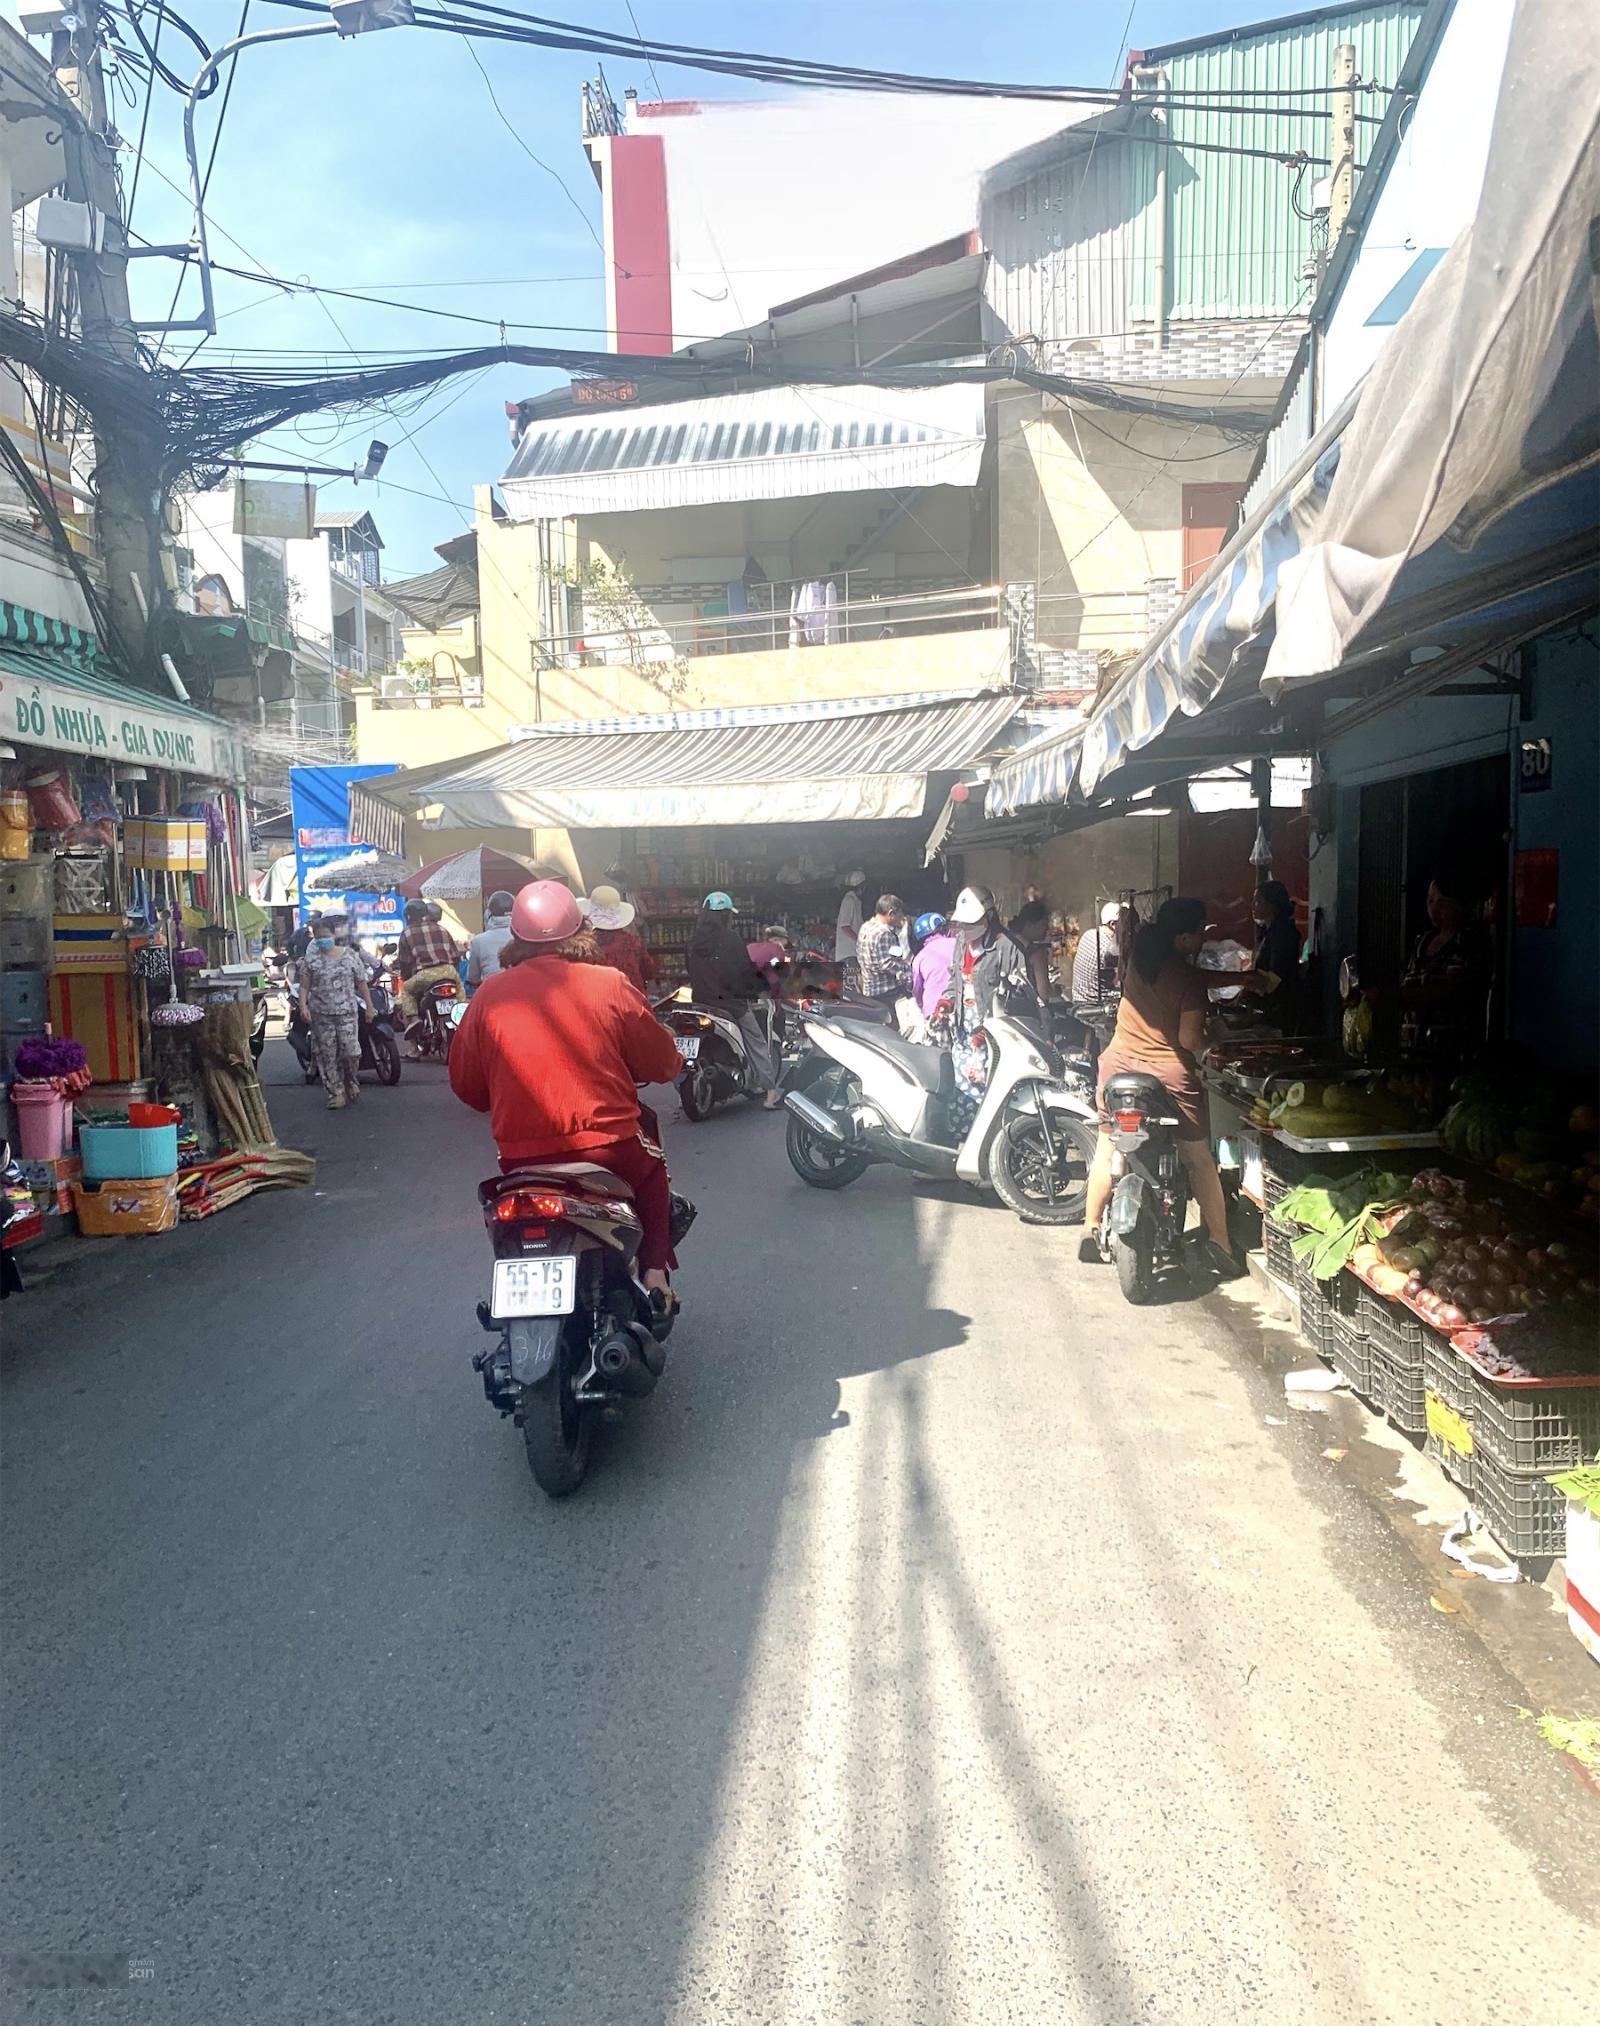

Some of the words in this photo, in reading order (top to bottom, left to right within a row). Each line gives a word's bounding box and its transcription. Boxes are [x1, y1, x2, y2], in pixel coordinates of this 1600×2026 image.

[16, 686, 45, 736] ĐỒ
[52, 705, 107, 751] NHỰA
[121, 720, 151, 756] GIA
[152, 728, 196, 767] DỤNG
[1521, 739, 1550, 777] 80
